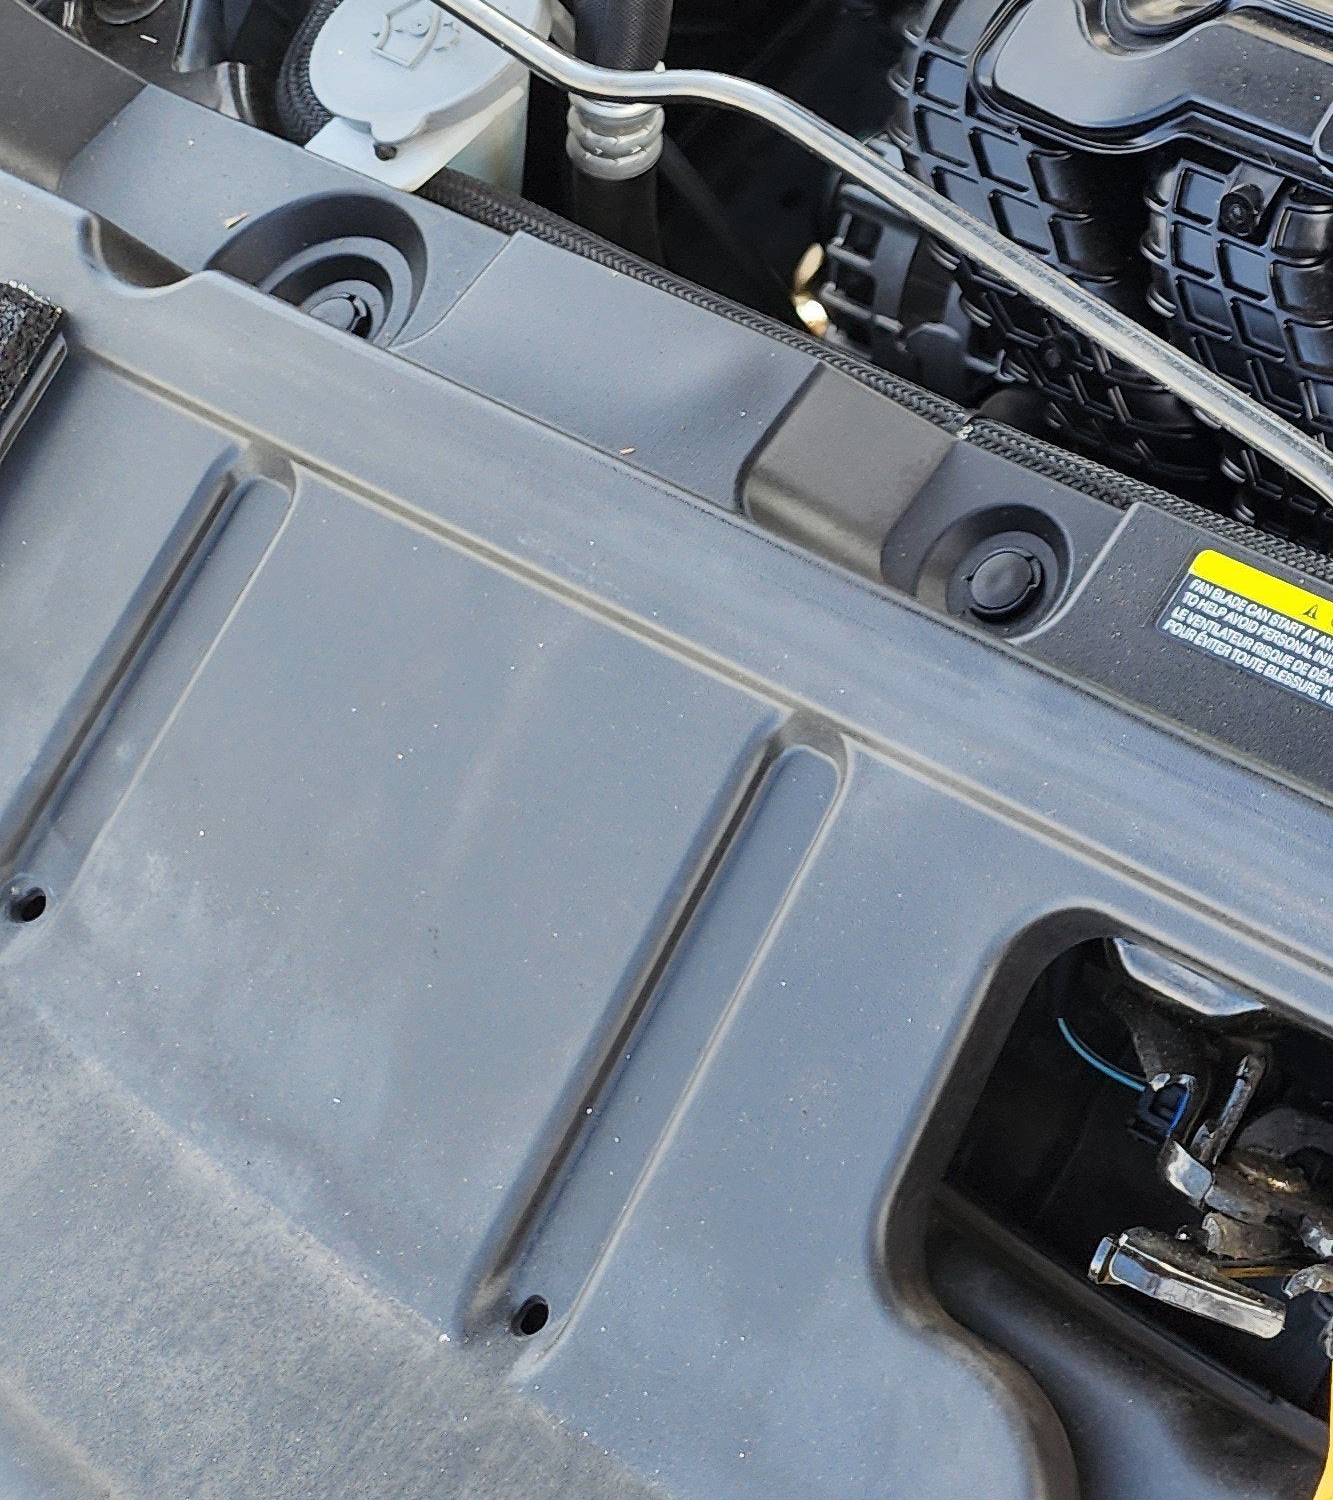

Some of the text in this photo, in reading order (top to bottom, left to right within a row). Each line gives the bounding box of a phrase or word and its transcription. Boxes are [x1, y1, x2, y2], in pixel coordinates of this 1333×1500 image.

[1170, 603, 1190, 623] LE
[1184, 610, 1255, 652] VENTILATEUR
[1249, 639, 1295, 670] RISQUE
[1290, 656, 1312, 676] DE
[1180, 589, 1201, 609] TO
[1196, 596, 1228, 621] HELP
[1224, 609, 1260, 635] AVOID
[1255, 622, 1316, 660] PERSONAL
[1187, 576, 1213, 598] FAN
[1209, 586, 1247, 613] BLADE
[1243, 601, 1272, 624] CAN
[1267, 611, 1305, 638] START
[1300, 625, 1319, 644] AT
[1161, 617, 1196, 643] POUR
[1192, 628, 1234, 658] ÉVITER
[1228, 646, 1267, 673] TOUTE
